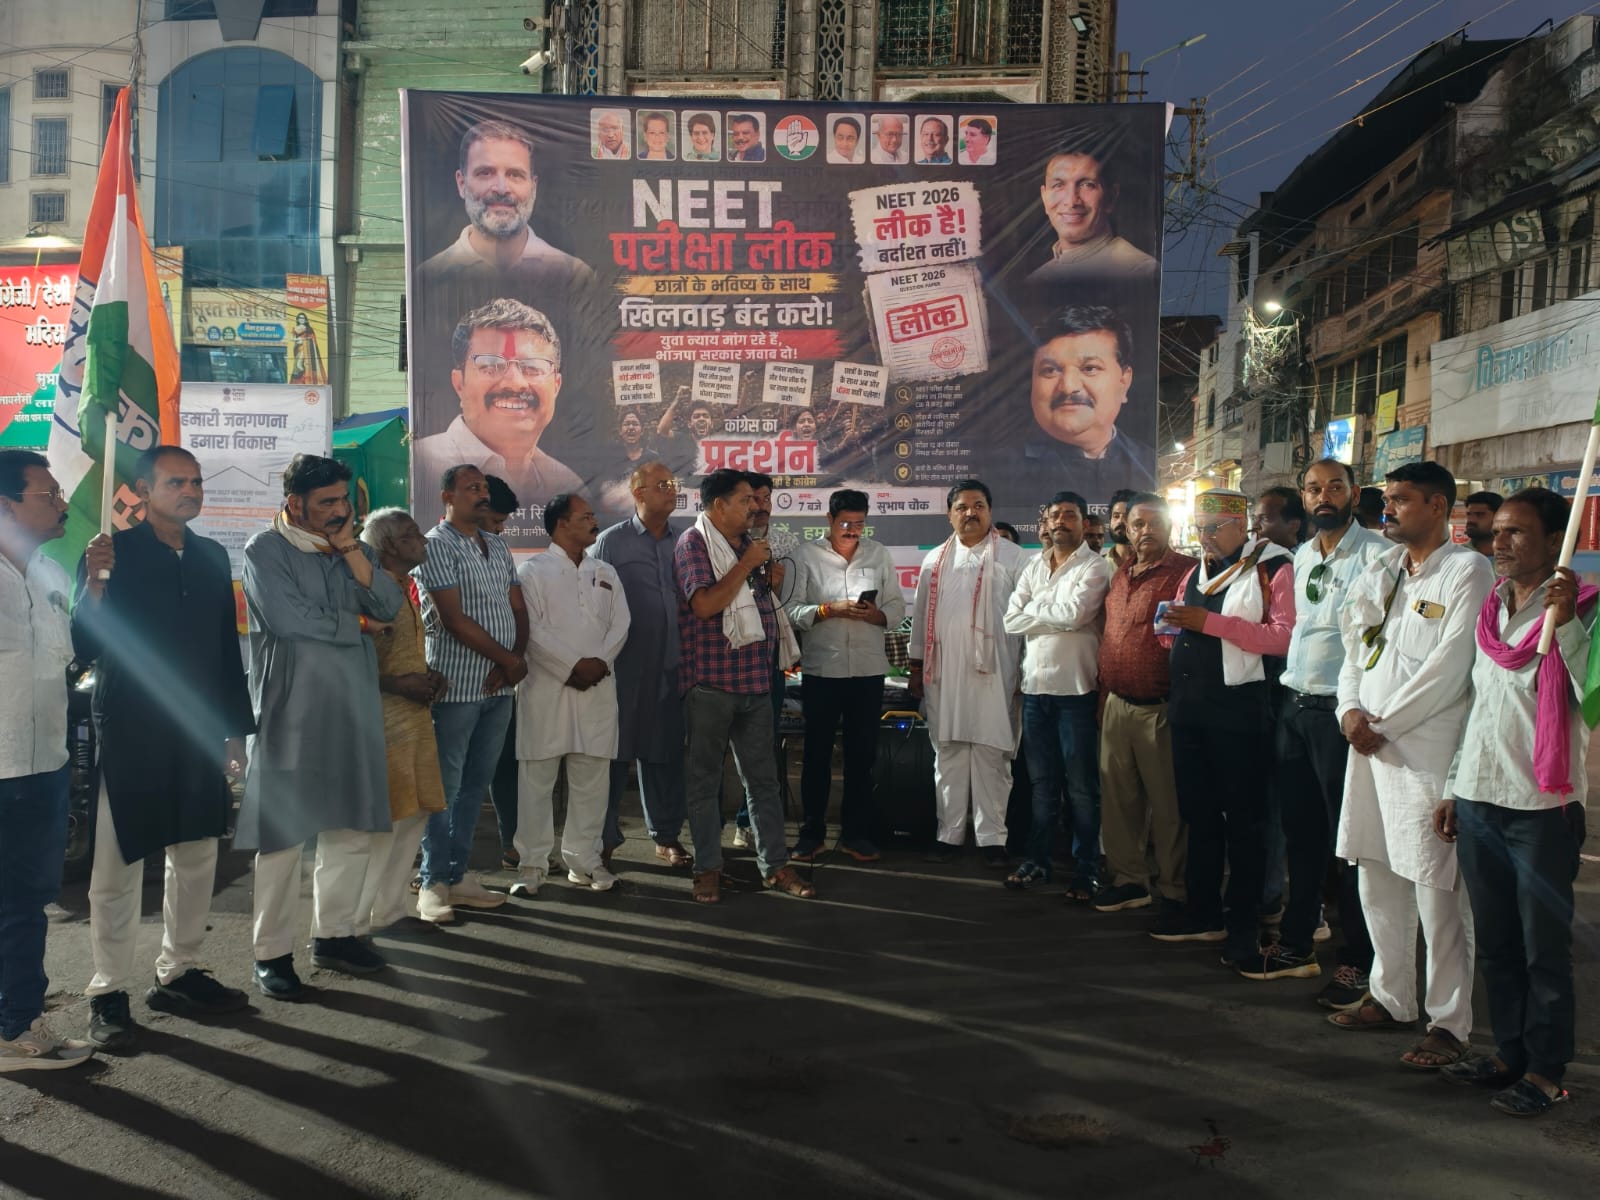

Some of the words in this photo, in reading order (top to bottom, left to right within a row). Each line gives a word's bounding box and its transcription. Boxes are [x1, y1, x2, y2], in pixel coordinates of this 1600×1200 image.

[632, 178, 783, 228] NEET
[876, 191, 916, 210] NEET
[922, 187, 960, 206] 2026
[873, 209, 932, 241] लीक
[936, 204, 966, 235] है!
[609, 219, 737, 271] परीक्षा
[744, 219, 836, 271] लीक
[877, 243, 927, 264] बर्दाश्त
[929, 238, 967, 258] नहीं!
[654, 275, 688, 293] छात्रों
[692, 276, 706, 292] के
[711, 275, 756, 292] भविष्य
[761, 275, 775, 292] के
[780, 276, 811, 291] साथ
[891, 273, 918, 287] NEET
[921, 270, 946, 282] 2026
[899, 284, 924, 293] QUESTION
[925, 281, 941, 289] PAPER
[618, 296, 727, 332] खिलवाड़
[733, 297, 770, 326] बंद
[775, 295, 833, 325] करो!
[896, 303, 957, 335] लीक
[660, 335, 684, 350] युवा
[687, 335, 719, 346] न्याय
[722, 332, 747, 346] मांग
[750, 332, 766, 346] रहे
[656, 349, 696, 361] भाजपा
[700, 349, 743, 360] सरकार
[744, 348, 778, 360] जवाब
[779, 347, 798, 360] दो!
[180, 408, 220, 428] हमारी
[223, 412, 288, 429] जनगणना
[724, 415, 760, 433] कांग्रेस
[762, 418, 778, 433] का
[189, 434, 230, 449] हमारा
[232, 431, 278, 450] विकास
[701, 430, 818, 474] प्रदर्शन
[798, 501, 804, 511] 7
[806, 499, 822, 512] बजे
[877, 500, 905, 513] सुभाष
[908, 497, 930, 511] चौक
